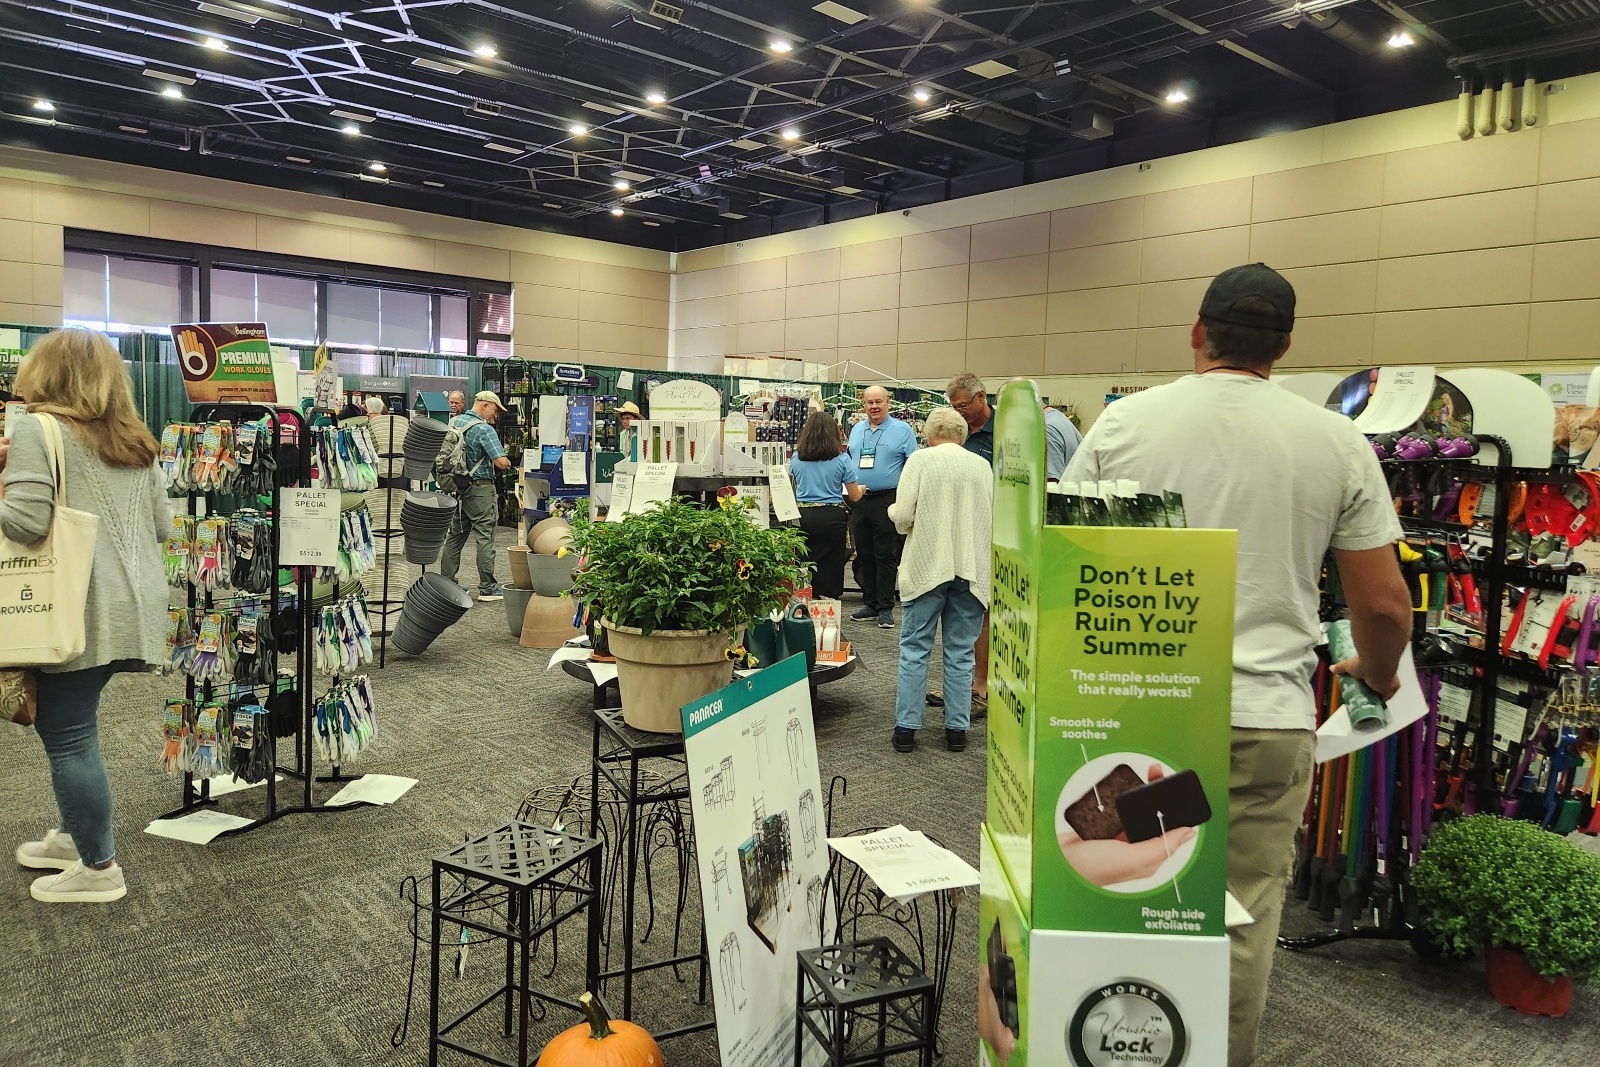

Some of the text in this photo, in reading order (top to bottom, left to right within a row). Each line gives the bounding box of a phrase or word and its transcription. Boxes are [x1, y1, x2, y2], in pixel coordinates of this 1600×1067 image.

[234, 325, 266, 337] Bellingham
[220, 351, 270, 365] PREMIUM
[247, 366, 271, 374] GLOVES
[686, 390, 702, 399] Pal
[1005, 461, 1029, 488] Originals
[294, 500, 328, 508] SPECIAL
[0, 555, 58, 569] riffinEx
[994, 549, 1030, 606] Don't Let
[1080, 564, 1195, 587] Don't Let
[1074, 588, 1200, 615] Poison Ivy
[1, 603, 54, 615] ROWSCAP
[993, 586, 1031, 657] Poison Ivy
[1075, 612, 1198, 634] Ruin Your
[1083, 635, 1187, 657] Summer
[992, 622, 1030, 691] Ruin Your
[1070, 669, 1201, 685] The simple solution
[994, 660, 1026, 728] Summer
[1077, 684, 1192, 699] that really works!
[689, 698, 723, 727] PANACEA
[1049, 717, 1121, 729] Smooth side
[1061, 729, 1107, 740] soothes
[860, 836, 904, 846] PALLET
[863, 842, 915, 852] SPECIAL
[1141, 907, 1205, 920] Rough side
[1144, 919, 1201, 931] exfoliates
[1100, 985, 1160, 1001] WORKS
[1099, 1034, 1155, 1053] Lock
[1110, 1052, 1163, 1064] Technology
